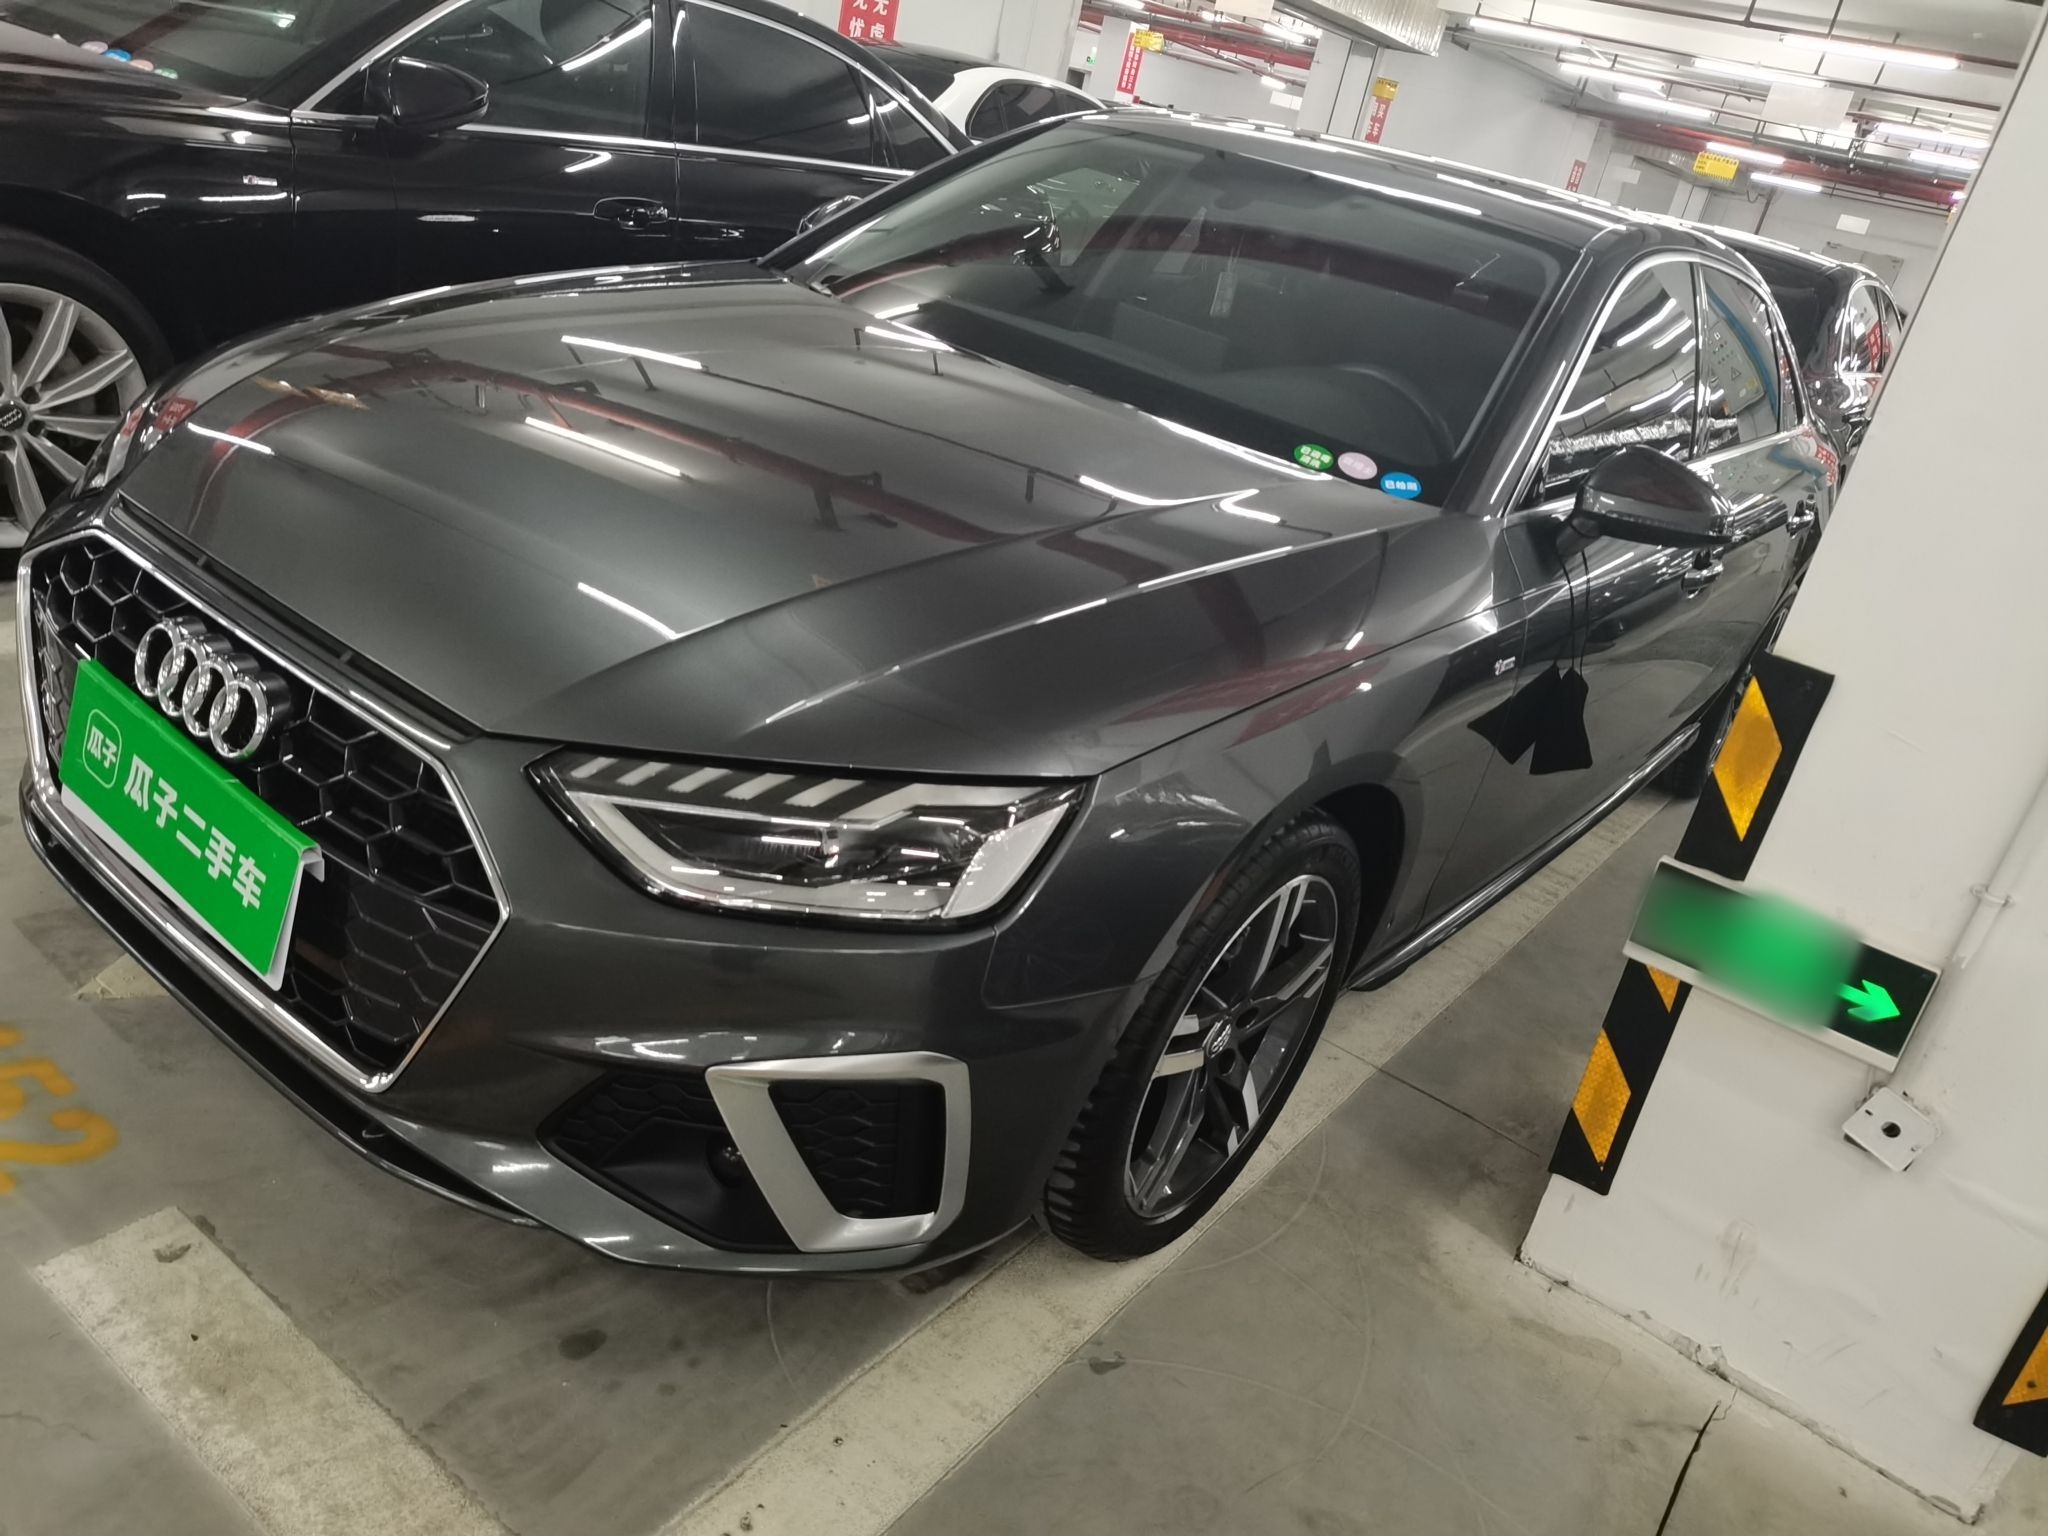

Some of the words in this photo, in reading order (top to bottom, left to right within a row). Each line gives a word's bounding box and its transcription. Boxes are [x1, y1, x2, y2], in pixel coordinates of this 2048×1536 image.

[86, 725, 118, 769] 瓜子
[123, 753, 267, 910] 瓜子二手车
